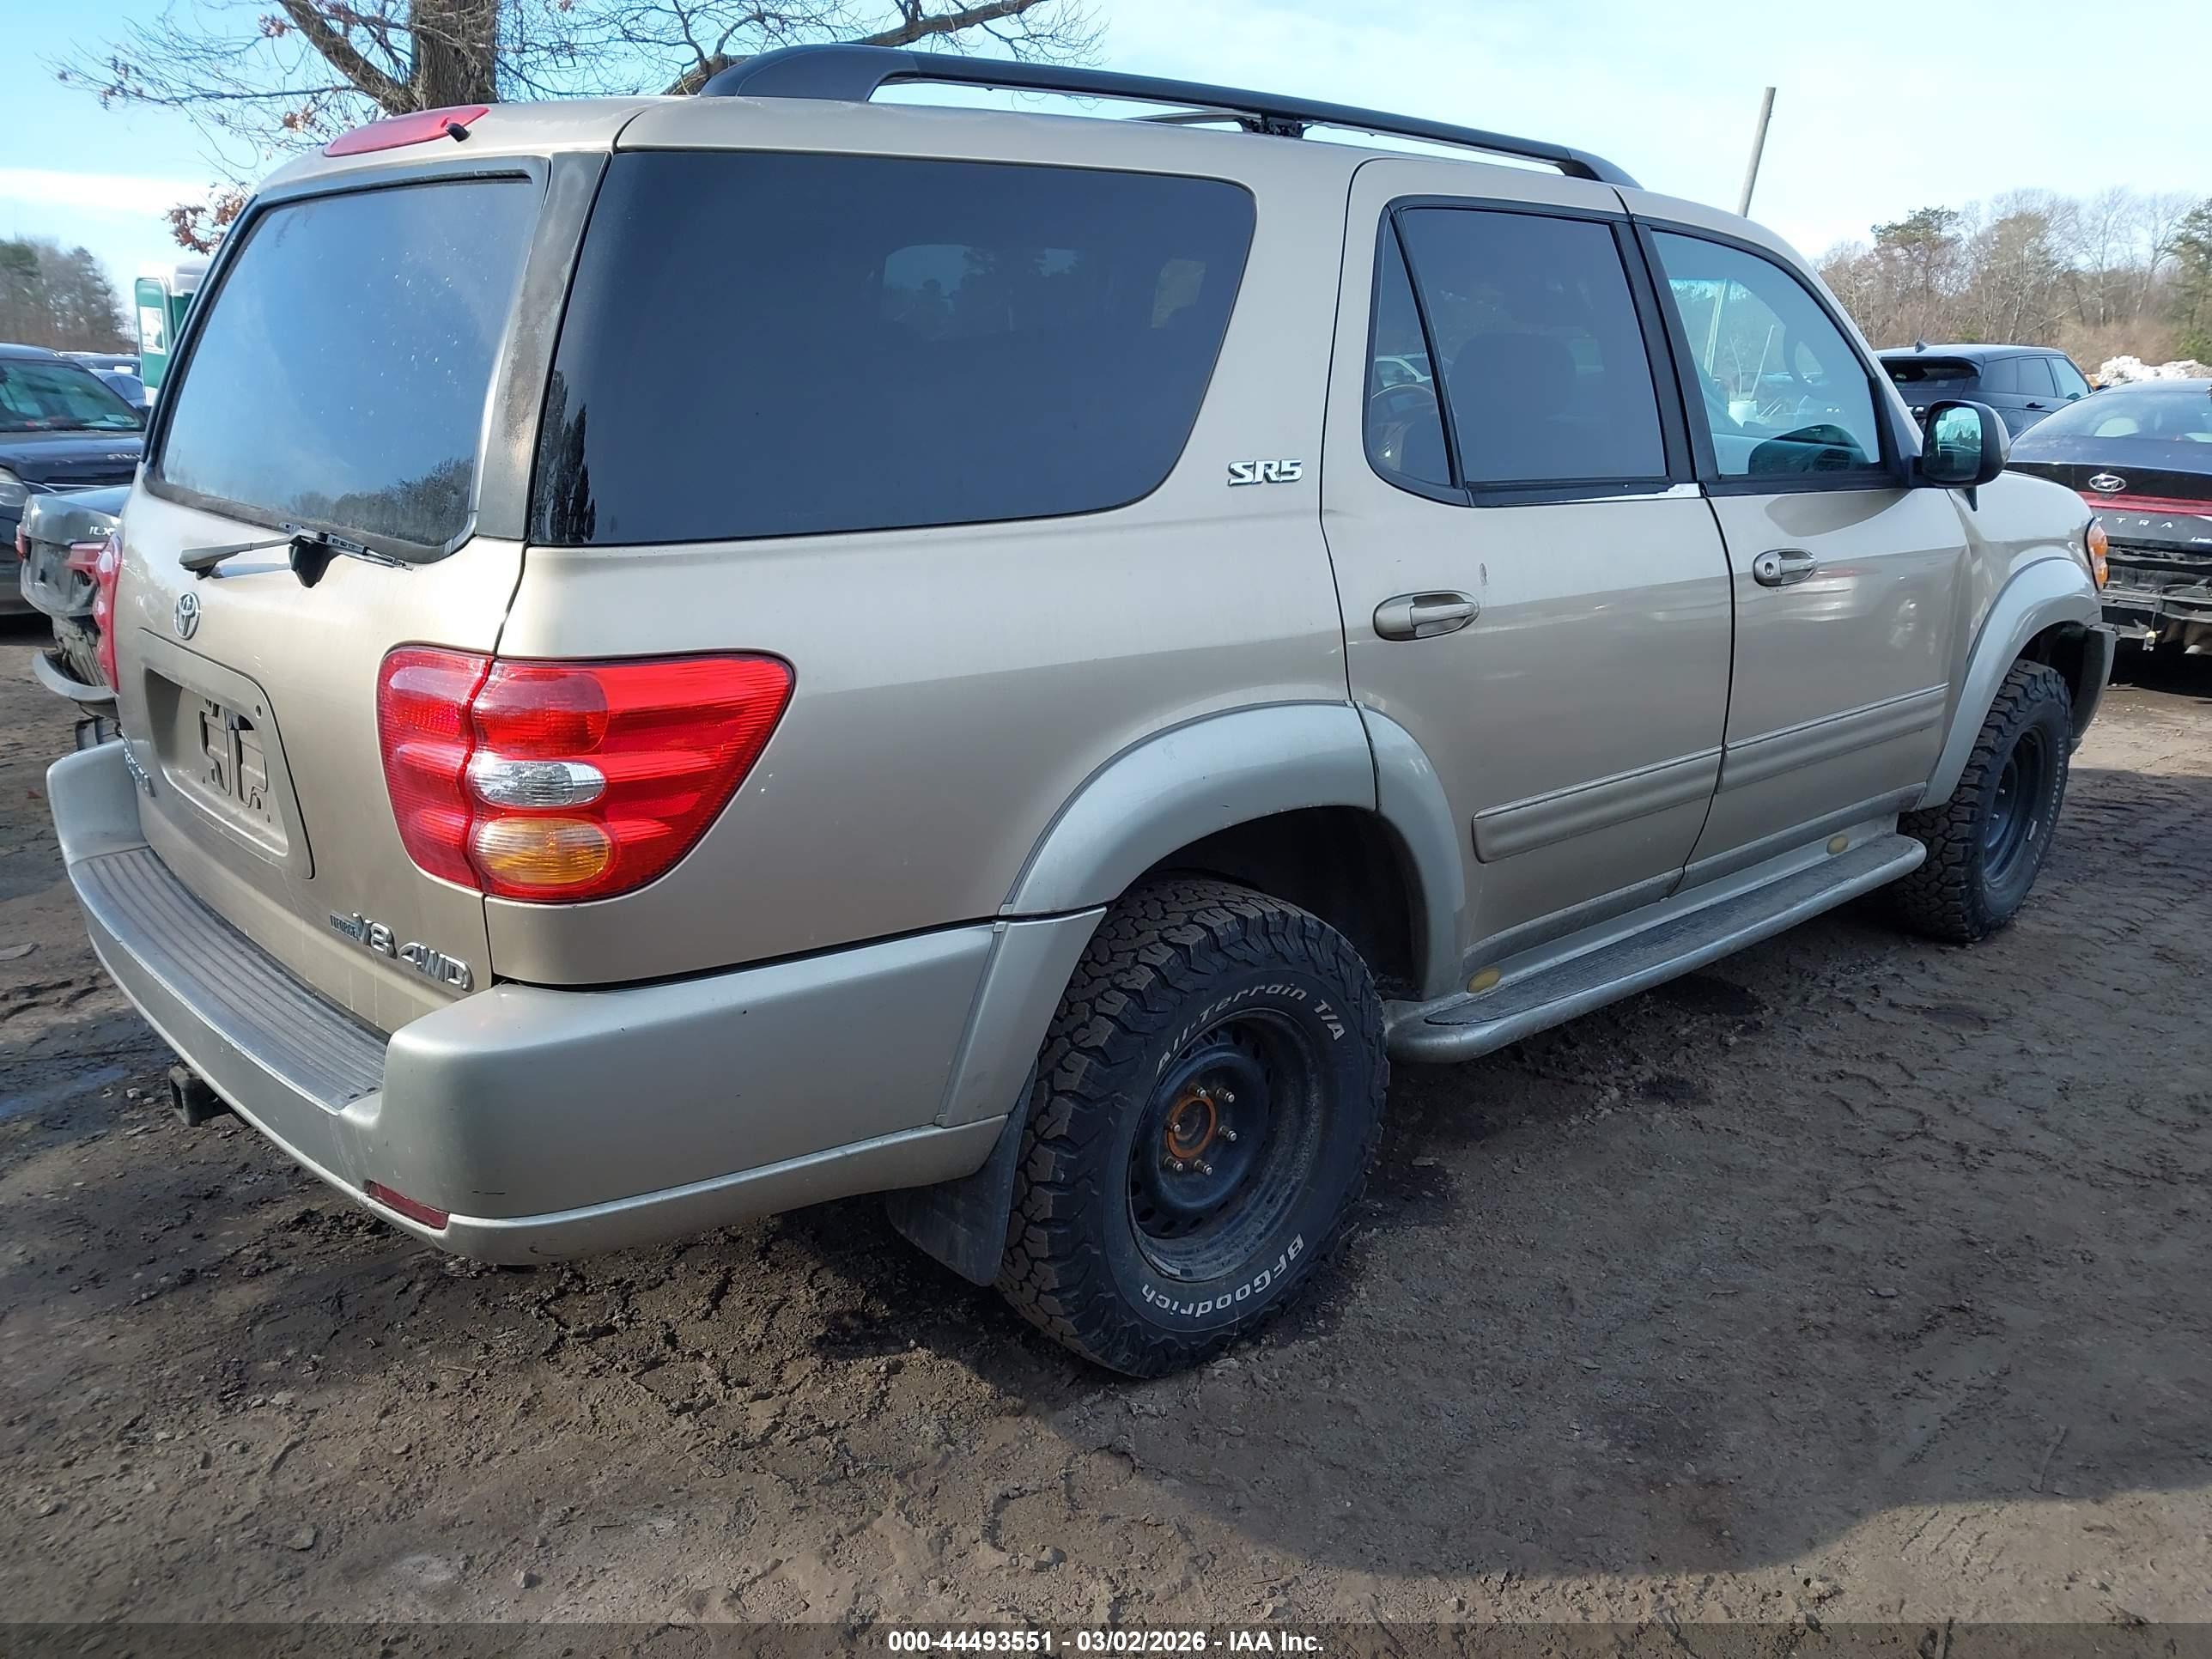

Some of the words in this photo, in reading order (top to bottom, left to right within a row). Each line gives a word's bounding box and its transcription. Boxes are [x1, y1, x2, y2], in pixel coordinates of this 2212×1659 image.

[1228, 459, 1304, 487] SR5
[88, 526, 117, 537] ILX
[352, 911, 398, 959] V8
[398, 942, 474, 993] 4WD
[1313, 999, 1346, 1042] T/A
[1141, 1233, 1304, 1318] BFGoodrich
